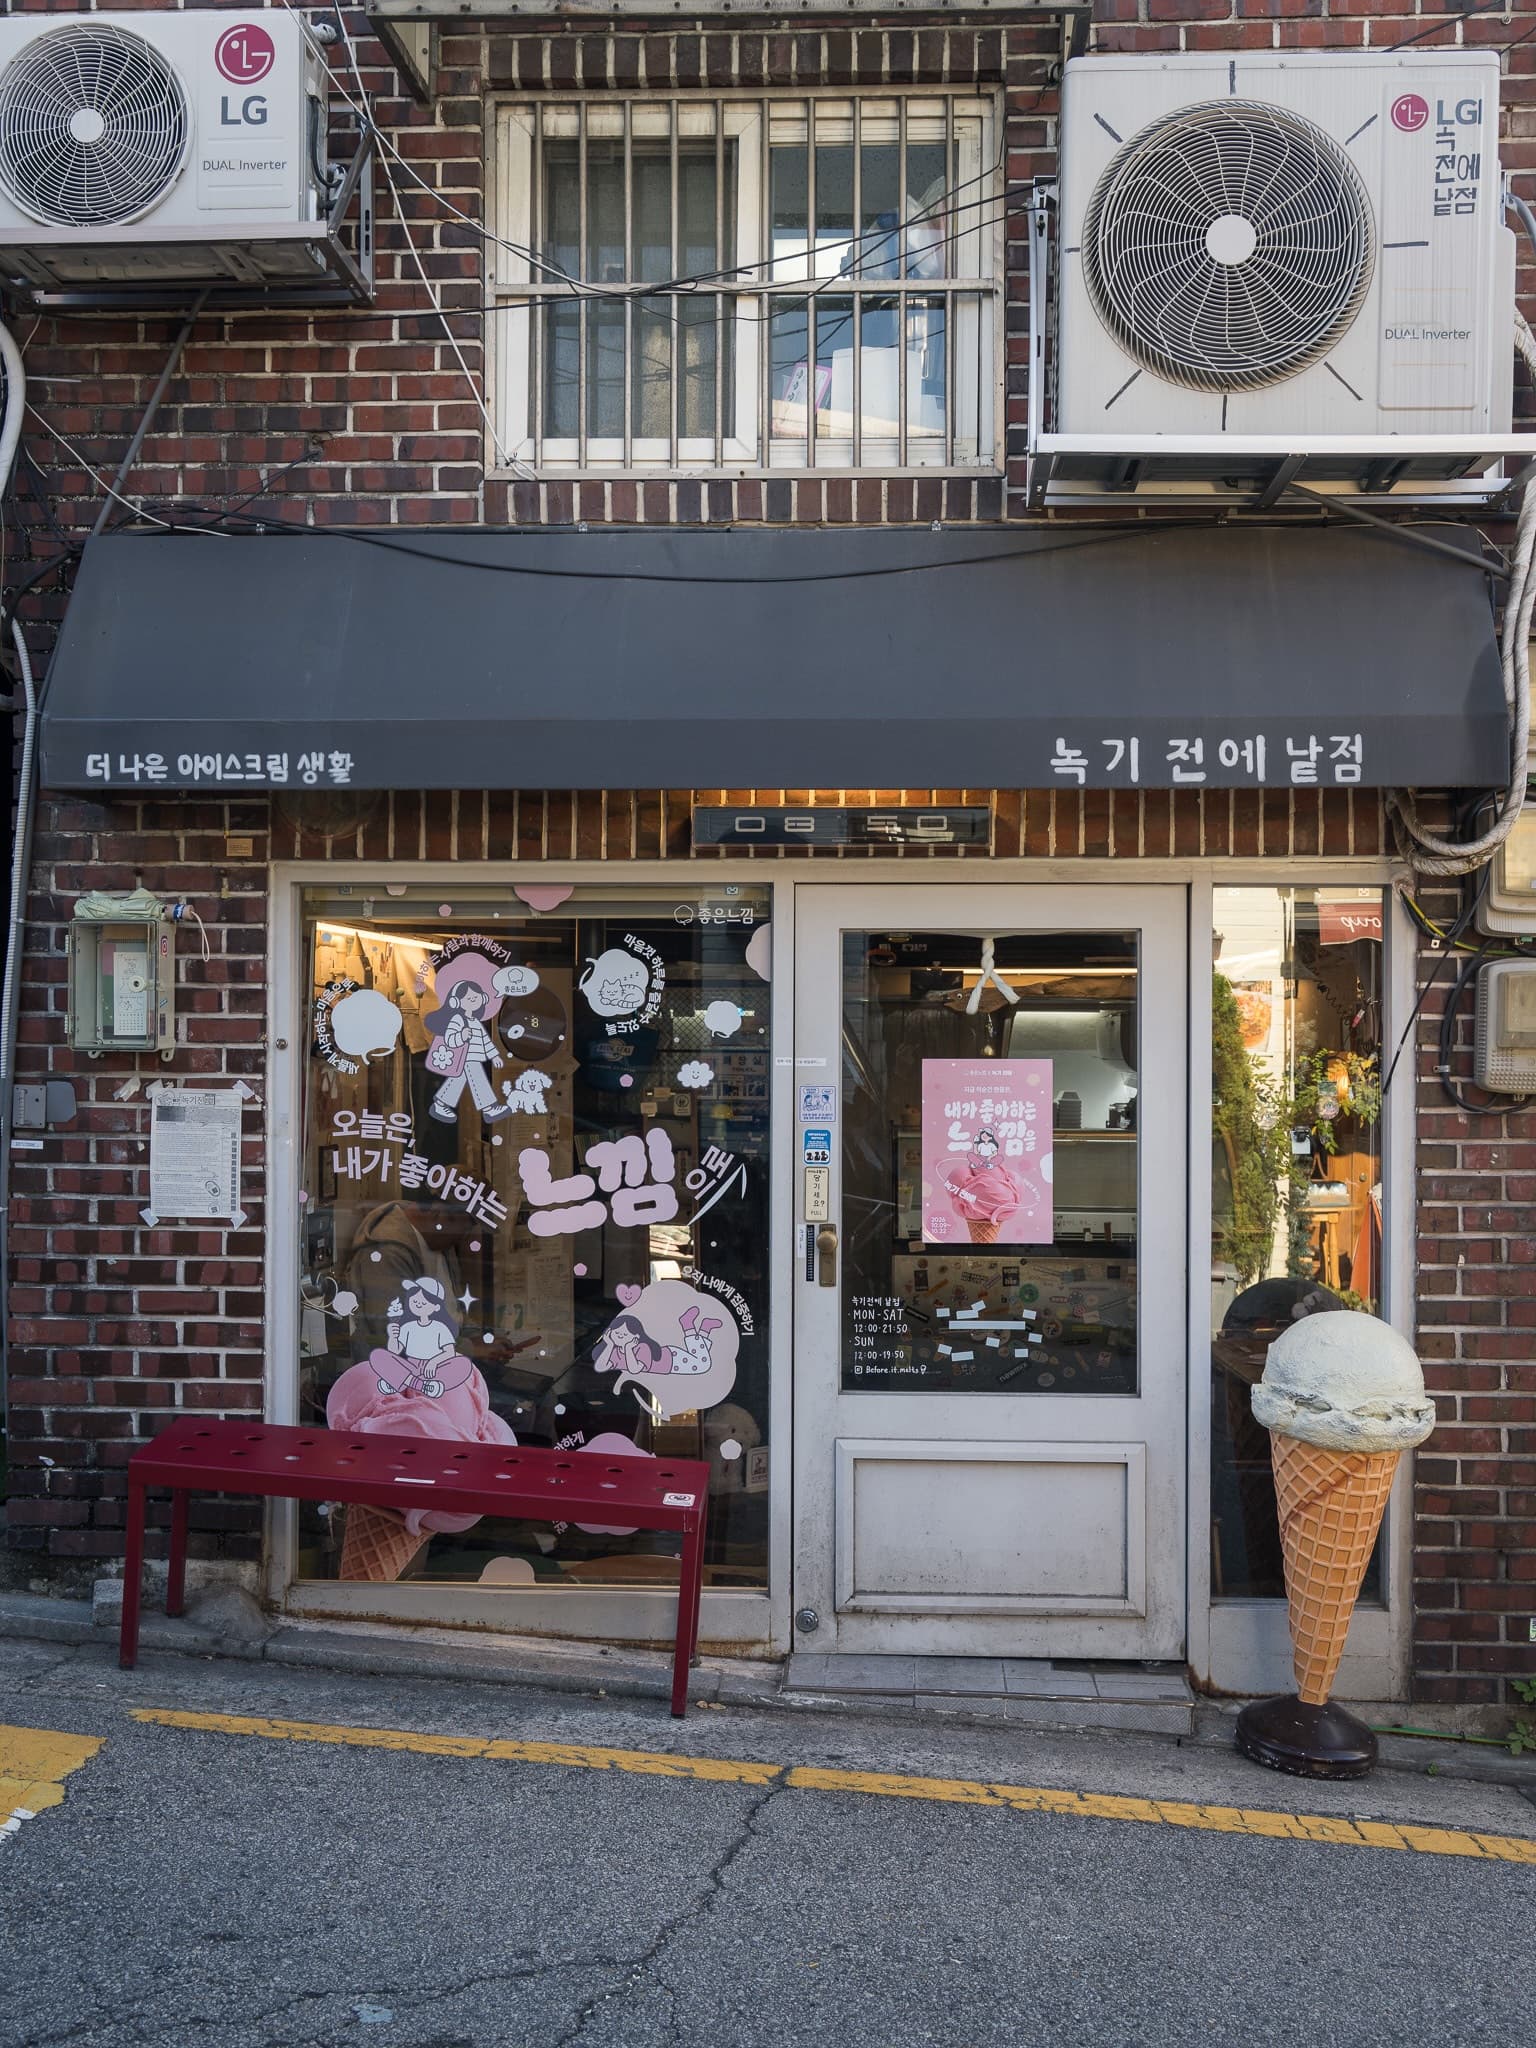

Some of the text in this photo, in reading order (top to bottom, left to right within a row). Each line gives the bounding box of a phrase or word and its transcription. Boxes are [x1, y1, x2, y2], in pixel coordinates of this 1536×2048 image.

[220, 96, 268, 125] LG
[203, 159, 287, 171] DUAL Inverter
[1435, 153, 1480, 183] 전에
[1385, 328, 1471, 340] DUAL Inverter
[86, 750, 354, 784] 더 나은 아이스크림 생활
[1050, 736, 1139, 784] 녹기
[1166, 735, 1266, 782] 전에
[698, 908, 753, 925] 좋은느낌
[440, 934, 469, 960] 사람과
[470, 933, 512, 963] 함께하기
[624, 933, 657, 960] 마음껏
[651, 955, 666, 991] 하루를
[316, 977, 355, 1010] 마음으로
[314, 1011, 333, 1055] 시작하는
[944, 1099, 1036, 1123] 내가 좋아하는
[332, 1108, 416, 1148] 오늘은,
[333, 1146, 393, 1183] 내가
[399, 1152, 508, 1230] 좋아하는
[682, 1265, 755, 1336] 오직 나에게 집중하기
[853, 1336, 874, 1346] SUN
